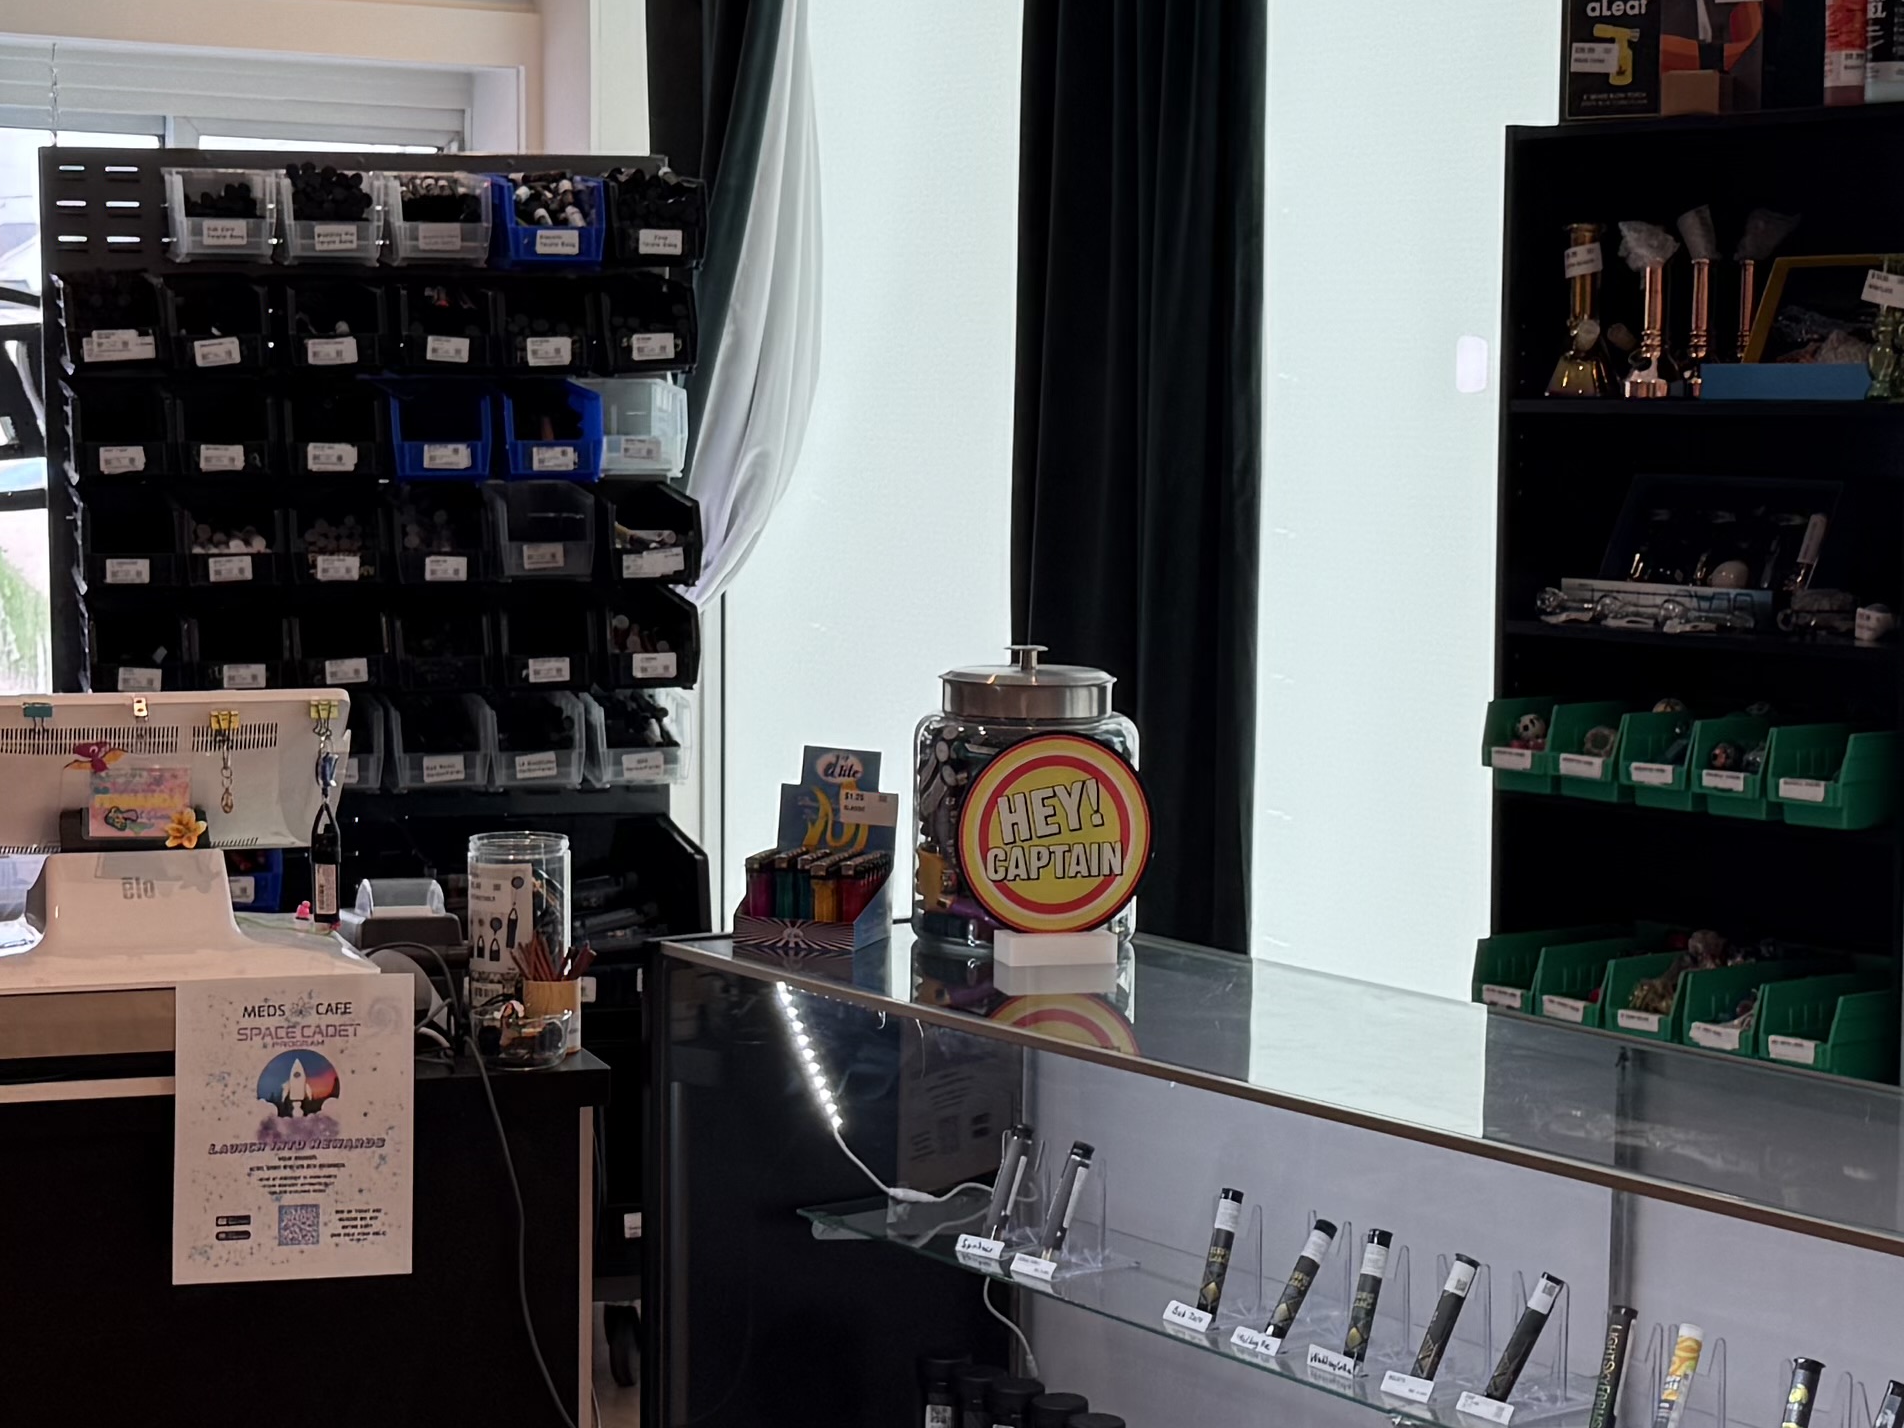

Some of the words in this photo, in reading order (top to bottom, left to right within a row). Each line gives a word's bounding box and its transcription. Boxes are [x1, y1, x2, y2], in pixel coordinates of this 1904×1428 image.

[996, 777, 1105, 845] HEY!
[986, 840, 1123, 883] CAPTAIN
[242, 1003, 286, 1019] MEDS
[315, 1001, 353, 1016] CAFE
[236, 1025, 296, 1042] SPACE
[300, 1023, 361, 1040] CADET
[271, 1039, 325, 1048] PROGRAM
[207, 1141, 267, 1155] LAUNCH
[269, 1140, 307, 1151] INTO
[308, 1137, 386, 1150] REWARDS
